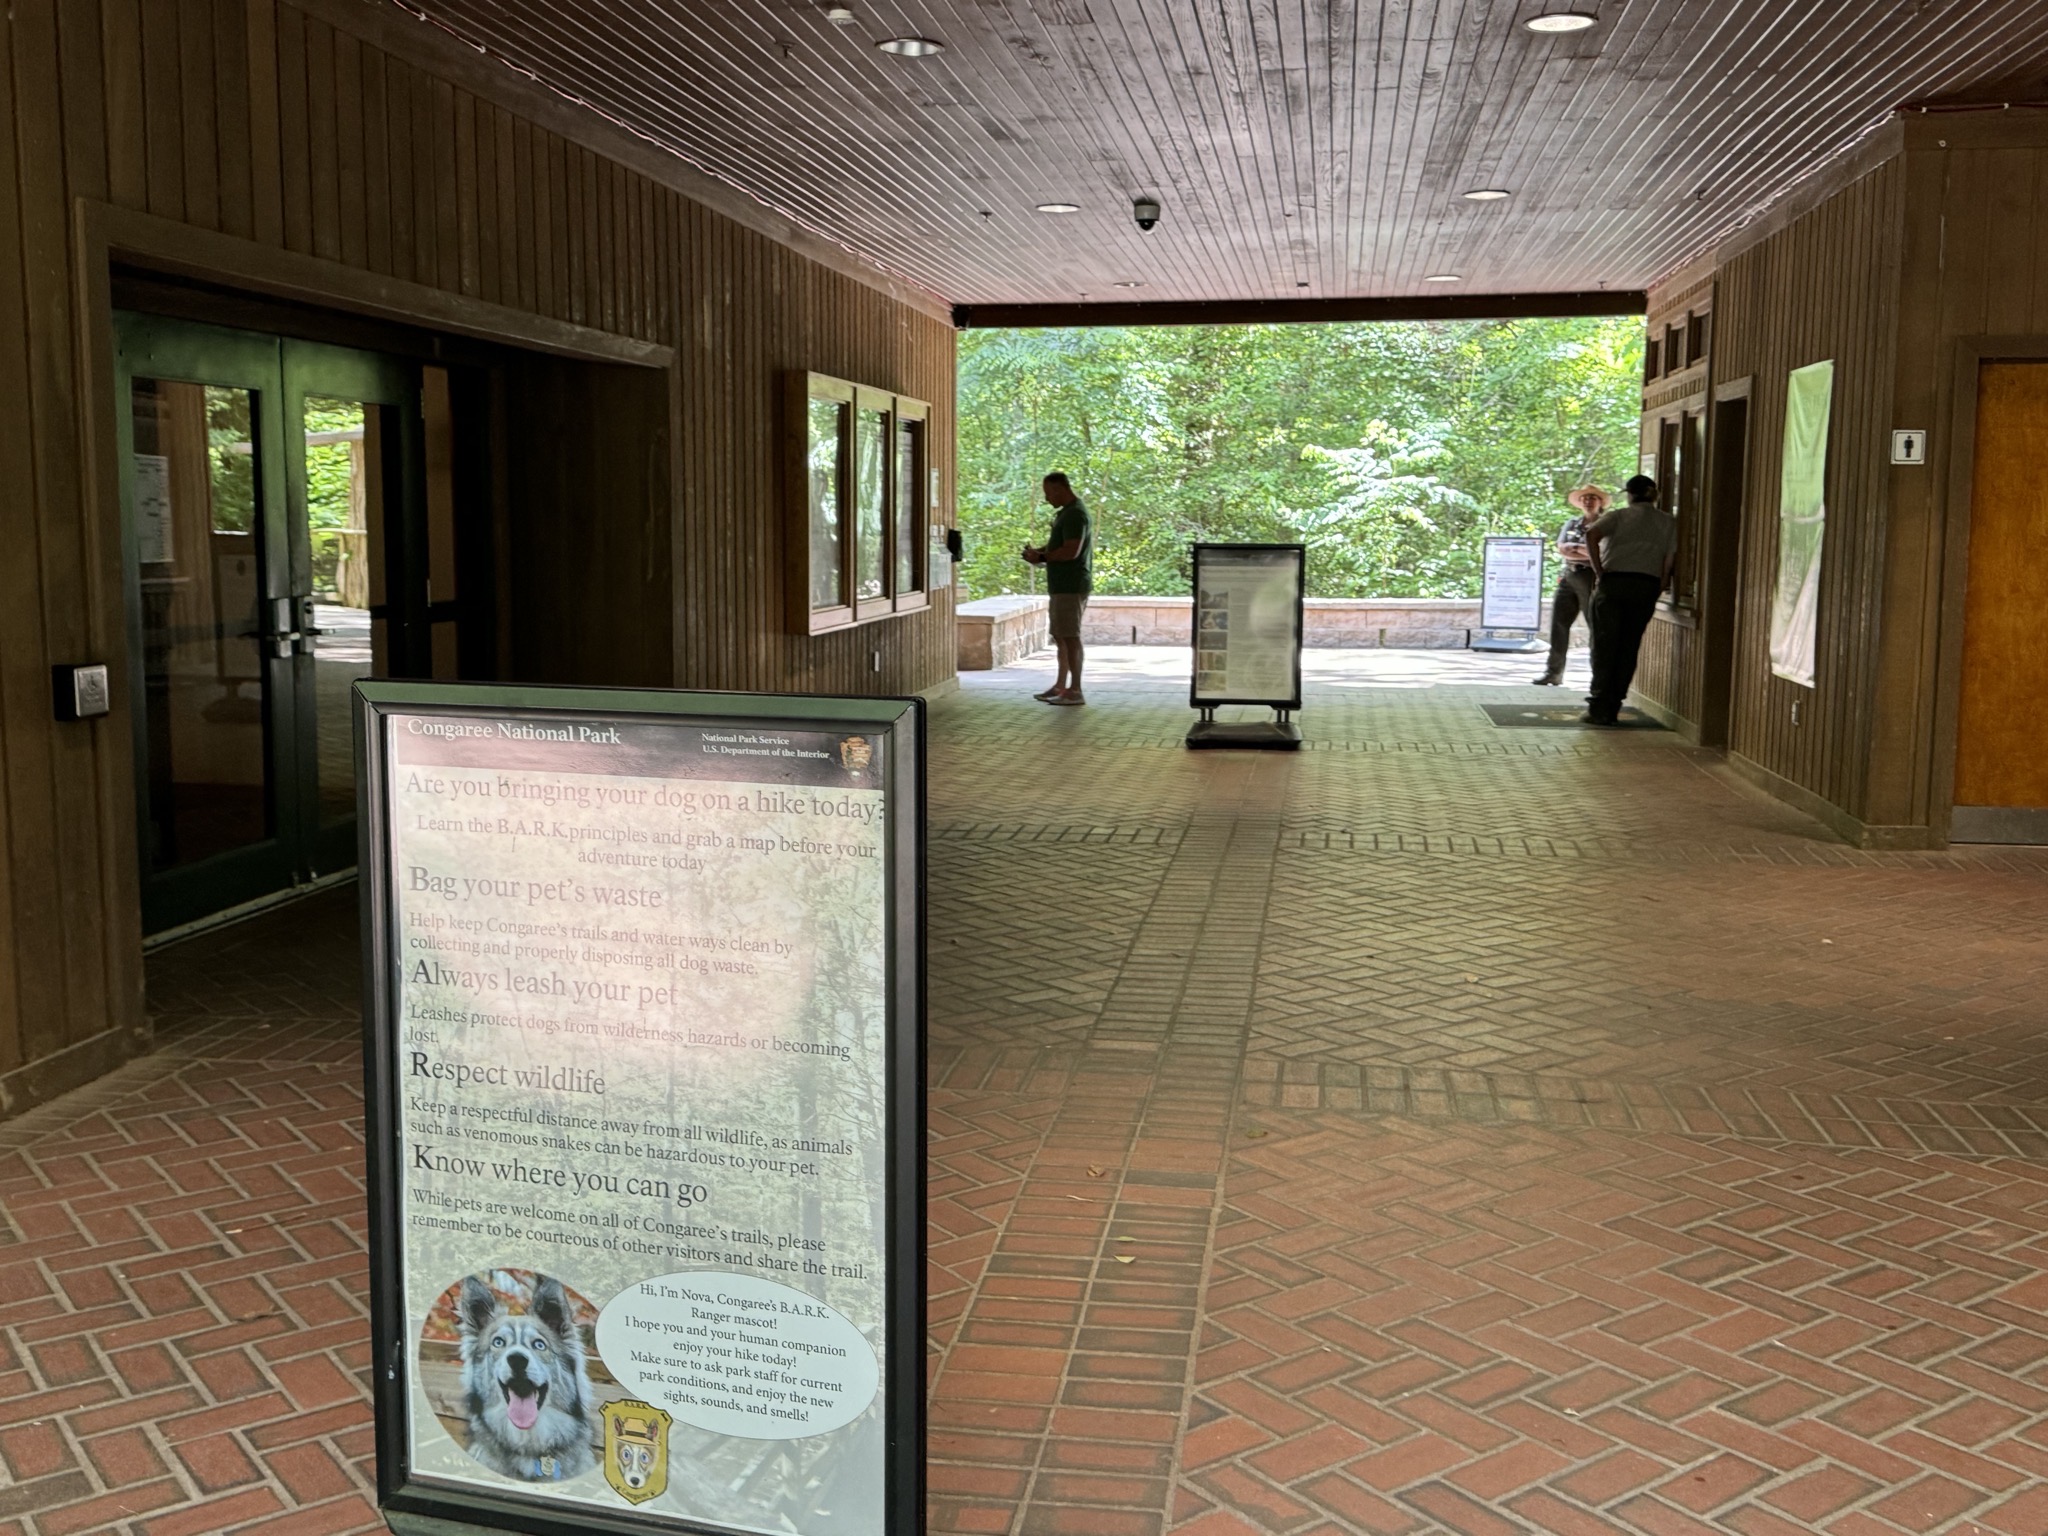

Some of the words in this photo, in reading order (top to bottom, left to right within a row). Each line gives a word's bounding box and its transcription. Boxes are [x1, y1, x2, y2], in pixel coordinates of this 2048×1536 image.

[408, 718, 493, 740] Congaree
[497, 723, 573, 742] National
[578, 726, 621, 745] Park
[702, 733, 737, 743] National
[739, 735, 758, 743] Park
[759, 735, 789, 745] Service
[703, 745, 719, 754] U.S.
[721, 746, 769, 757] Department
[772, 749, 780, 757] of
[782, 749, 795, 757] the
[796, 750, 830, 759] Interior
[405, 772, 444, 794] Are
[451, 782, 491, 801] you
[497, 776, 589, 808] bringing
[596, 787, 646, 809] your
[654, 785, 696, 815] dog
[703, 793, 730, 810] on
[738, 798, 750, 811] a
[757, 791, 805, 815] hike
[417, 815, 463, 831] Learn
[468, 817, 492, 833] the
[653, 831, 682, 845] and
[687, 833, 722, 849] grab
[727, 837, 735, 848] a
[741, 838, 775, 856] map
[780, 836, 832, 854] before
[835, 844, 876, 860] your
[578, 849, 658, 868] adventure
[662, 855, 706, 874] today
[409, 866, 457, 899] Bag
[463, 878, 520, 901] your
[528, 878, 585, 906] pet's
[594, 884, 662, 908] waste
[410, 913, 445, 931] Help
[450, 915, 483, 934] keep
[486, 917, 568, 938] Congaree's
[571, 925, 607, 941] trails
[611, 928, 638, 943] and
[644, 932, 684, 946] water
[689, 935, 725, 950] ways
[730, 936, 769, 954] clean
[775, 939, 793, 959] by
[411, 935, 480, 957] collecting
[484, 941, 510, 955] and
[515, 945, 577, 963] properly
[582, 944, 653, 970] disposing
[658, 954, 674, 968] all
[680, 955, 708, 975] dog
[714, 960, 758, 975] waste.
[411, 959, 498, 996] Always
[505, 968, 566, 995] leash
[573, 980, 631, 1004] your
[638, 984, 678, 1011] pet
[410, 1026, 439, 1043] lost.
[411, 1004, 467, 1023] Leashes
[471, 1012, 522, 1029] protect
[526, 1015, 560, 1034] dogs
[565, 1018, 598, 1035] from
[604, 1022, 684, 1043] wilderness
[688, 1028, 746, 1048] hazards
[751, 1038, 768, 1050] or
[772, 1036, 850, 1062] becoming
[410, 1052, 508, 1088] Respect
[515, 1065, 605, 1095] wildlife
[411, 1097, 446, 1115] Keep
[450, 1104, 457, 1115] a
[462, 1104, 532, 1123] respectful
[537, 1110, 597, 1130] distance
[601, 1120, 639, 1138] away
[643, 1121, 680, 1138] from
[684, 1126, 701, 1140] all
[706, 1128, 768, 1149] wildlife,
[772, 1137, 787, 1148] as
[792, 1138, 853, 1155] animals
[411, 1120, 442, 1135] such
[446, 1126, 460, 1137] as
[465, 1127, 538, 1146] venomous
[542, 1135, 591, 1152] snakes
[595, 1141, 620, 1155] can
[625, 1141, 643, 1157] be
[647, 1145, 725, 1166] hazardous
[730, 1154, 745, 1168] to
[750, 1158, 786, 1175] your
[789, 1161, 819, 1177] pet.
[413, 1144, 485, 1177] Know
[492, 1158, 566, 1187] where
[573, 1170, 620, 1195] you
[626, 1178, 671, 1199] can
[677, 1183, 707, 1208] go
[413, 1189, 452, 1208] While
[455, 1198, 482, 1215] pets
[486, 1203, 507, 1214] are
[511, 1204, 575, 1223] welcome
[579, 1214, 599, 1226] on
[602, 1213, 619, 1228] all
[624, 1216, 639, 1231] of
[644, 1217, 727, 1239] Congaree's
[731, 1229, 773, 1248] trails,
[778, 1234, 826, 1251] please
[413, 1214, 483, 1234] remember
[488, 1225, 501, 1237] to
[505, 1223, 522, 1238] be
[526, 1230, 599, 1248] courteous
[603, 1237, 620, 1250] of
[622, 1239, 663, 1255] other
[666, 1244, 720, 1262] visitors
[724, 1251, 753, 1267] and
[757, 1254, 798, 1272] share
[803, 1260, 826, 1275] the
[832, 1264, 867, 1279] trail.
[641, 1284, 657, 1297] Hi,
[660, 1286, 678, 1298] I'm
[682, 1289, 714, 1304] Nova,
[717, 1294, 776, 1311] Congaree's
[780, 1302, 829, 1318] B.A.R.K.
[691, 1307, 731, 1324] Ranger
[734, 1315, 777, 1329] mascot!
[625, 1316, 629, 1326] I
[633, 1316, 660, 1332] hope
[663, 1324, 683, 1334] you
[687, 1326, 707, 1336] and
[711, 1330, 736, 1341] your
[740, 1331, 778, 1347] human
[781, 1341, 846, 1357] companion
[673, 1342, 703, 1356] enjoy
[706, 1347, 732, 1357] your
[736, 1348, 759, 1361] hike
[762, 1352, 797, 1369] today!
[631, 1350, 661, 1364] Make
[664, 1358, 687, 1368] sure
[691, 1360, 701, 1370] to
[705, 1362, 722, 1373] ask
[726, 1366, 750, 1378] park
[754, 1370, 778, 1382] staff
[781, 1372, 797, 1385] for
[801, 1378, 842, 1392] current
[640, 1371, 664, 1382] park
[667, 1374, 729, 1393] conditions,
[732, 1385, 752, 1395] and
[756, 1388, 786, 1403] enjoy
[789, 1391, 807, 1404] the
[811, 1397, 834, 1408] new
[663, 1390, 698, 1404] sights,
[701, 1396, 743, 1412] sounds,
[747, 1404, 767, 1415] and
[771, 1407, 809, 1422] smells!
